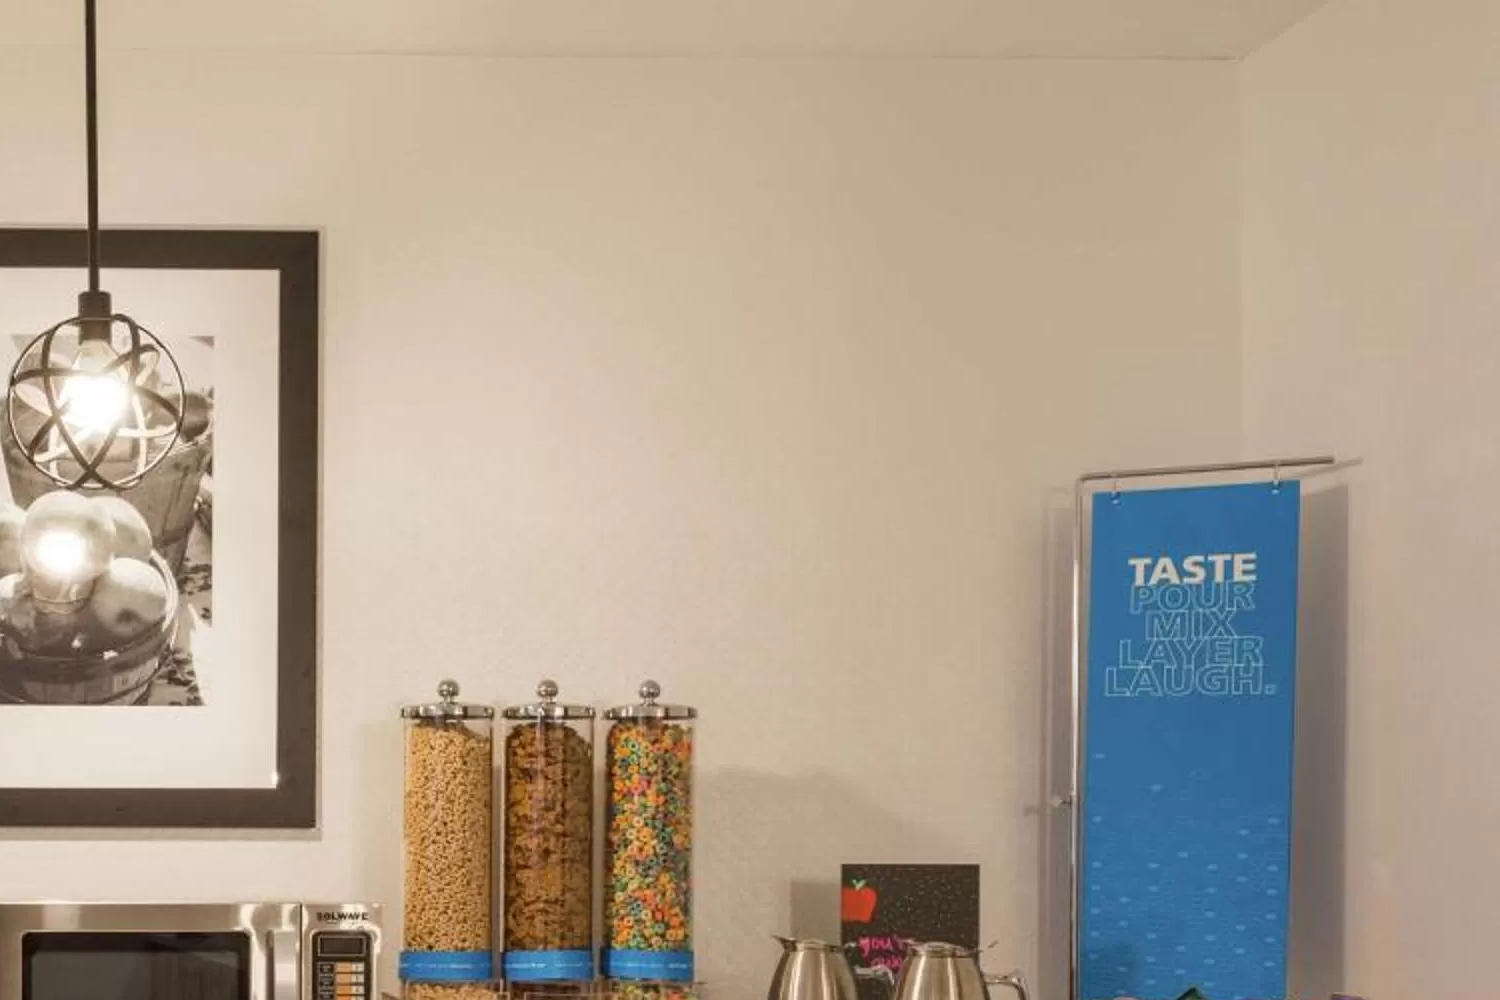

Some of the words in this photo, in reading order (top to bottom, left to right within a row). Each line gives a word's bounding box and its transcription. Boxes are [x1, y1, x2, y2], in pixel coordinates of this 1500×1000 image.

[1127, 552, 1257, 587] TASTE
[1129, 580, 1256, 615] POUR
[1145, 608, 1236, 641] MIX
[1119, 636, 1264, 670] LAYER
[1105, 665, 1277, 697] LAUGH.
